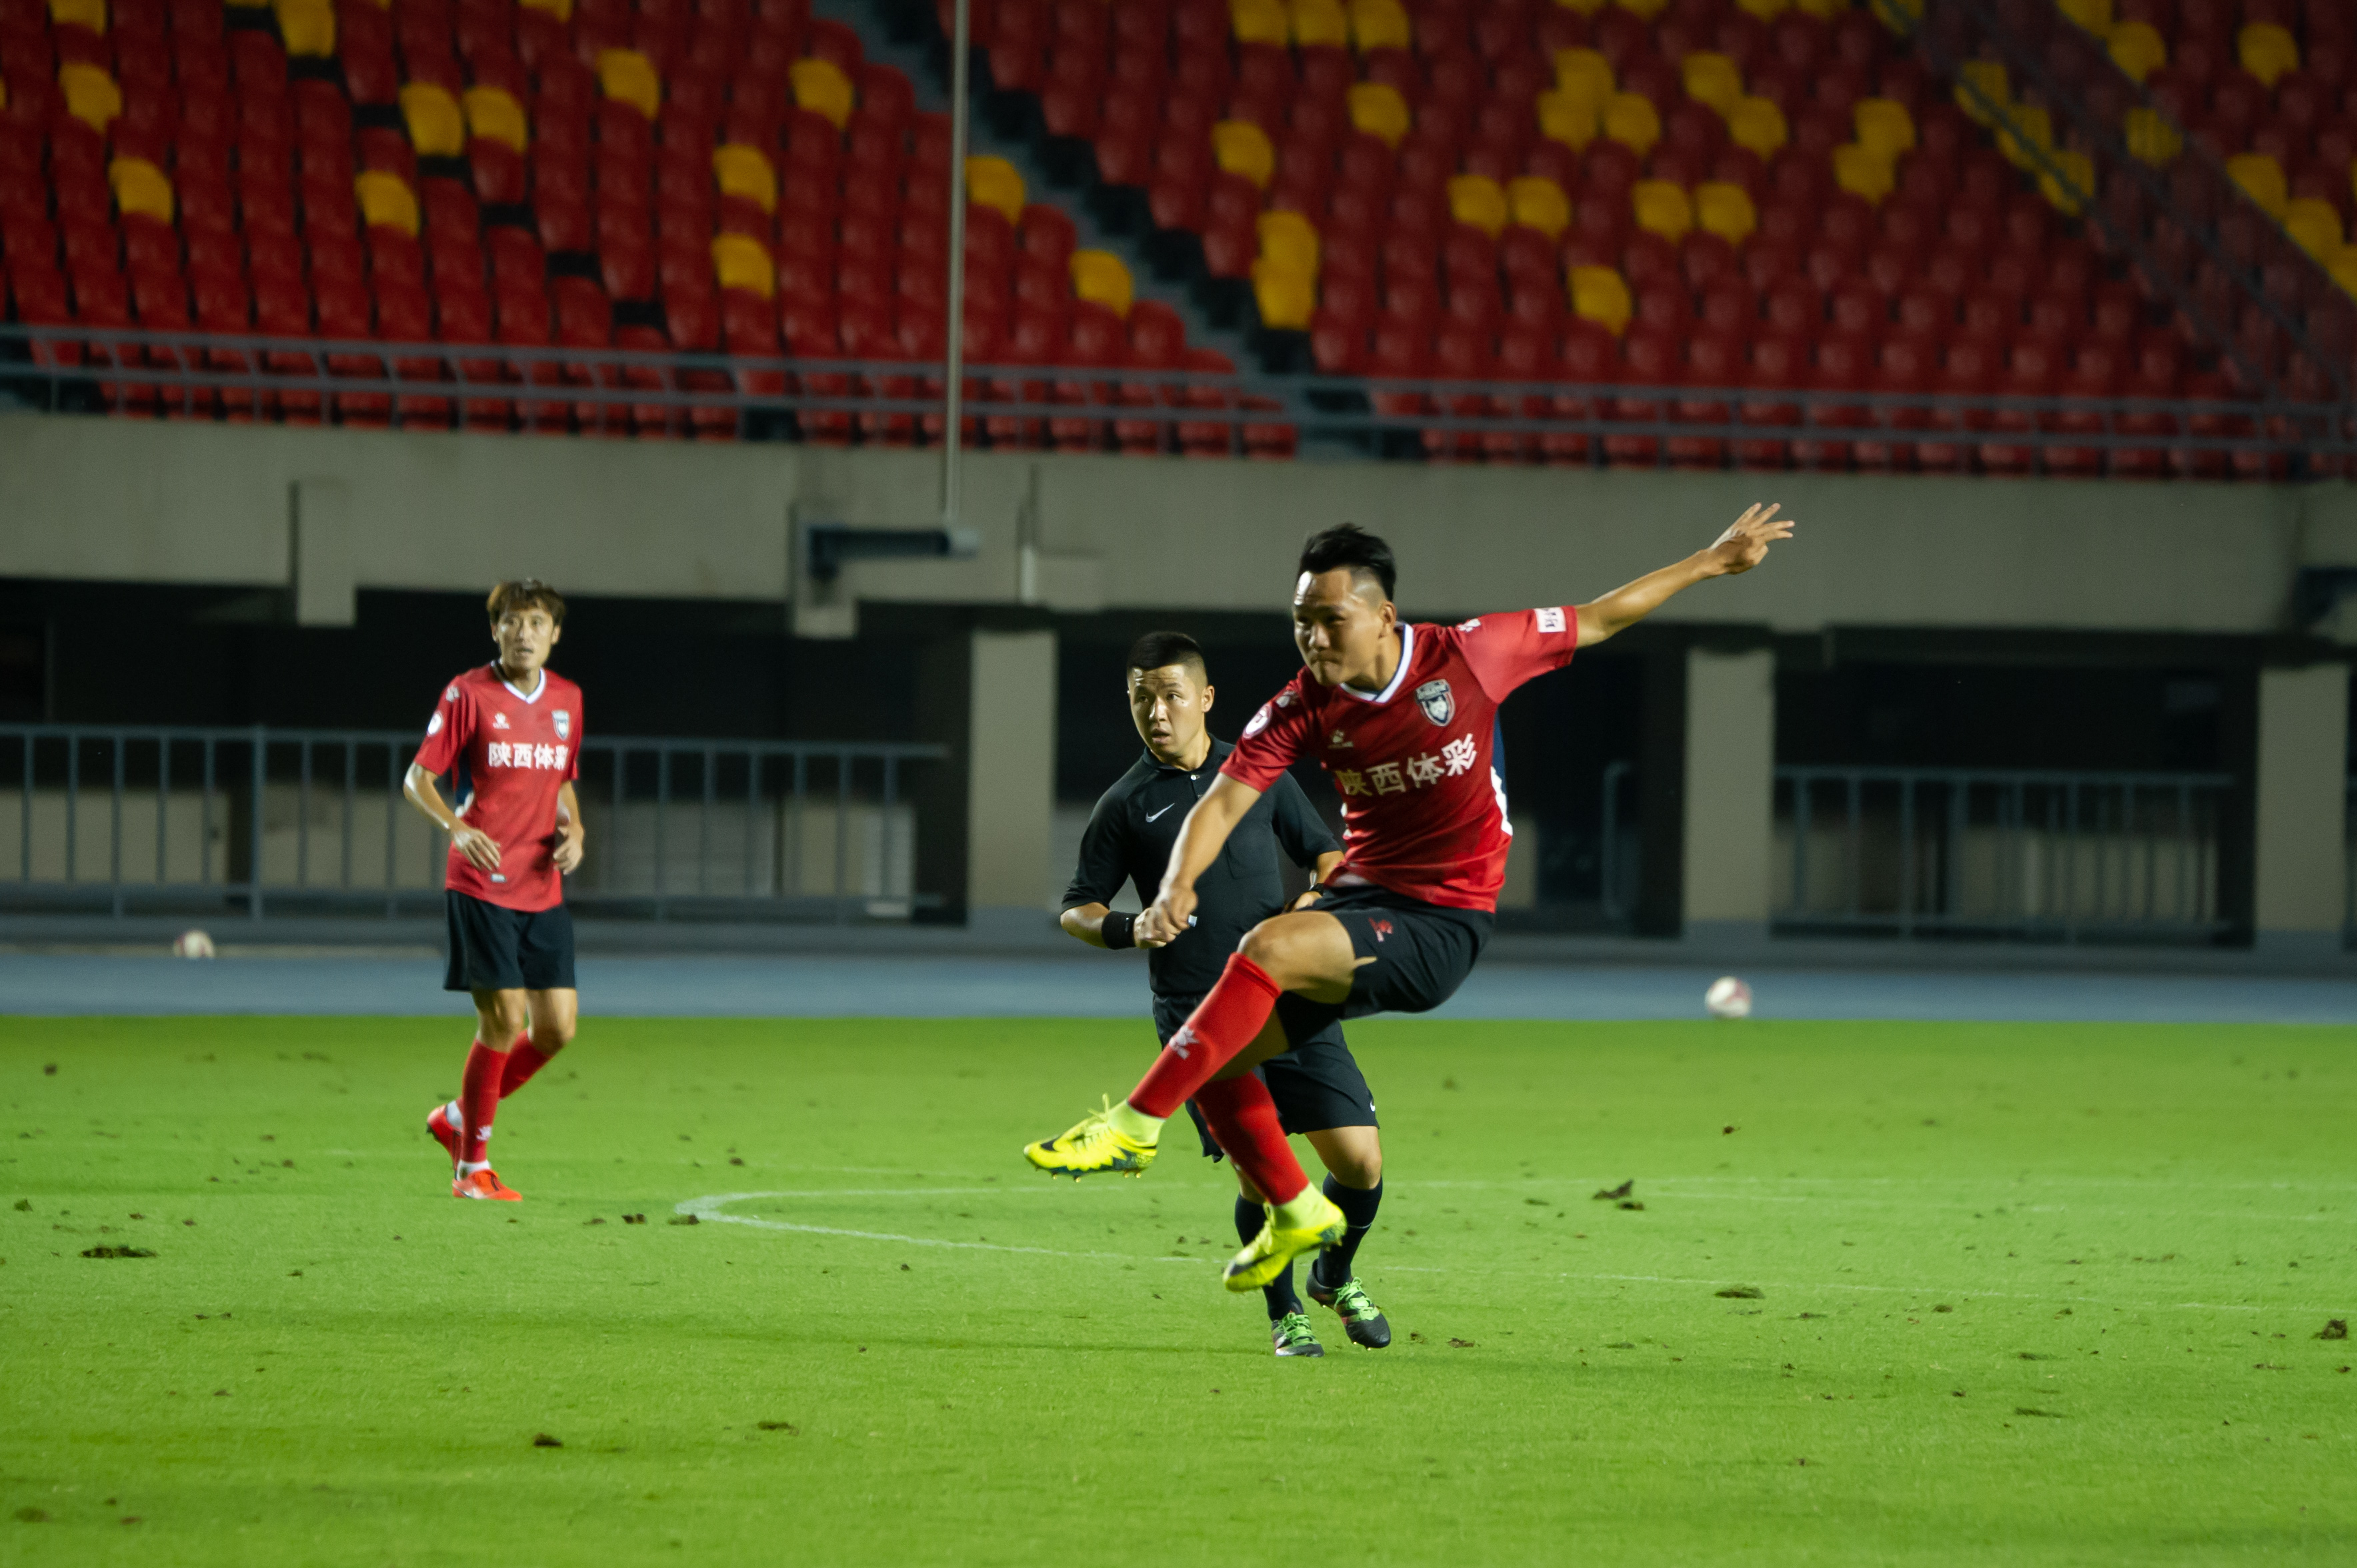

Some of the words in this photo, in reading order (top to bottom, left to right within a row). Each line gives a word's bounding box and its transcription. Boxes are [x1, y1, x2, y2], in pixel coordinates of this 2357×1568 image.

[487, 741, 569, 771] 陕西体彩
[1336, 733, 1478, 796] 陕西体彩
